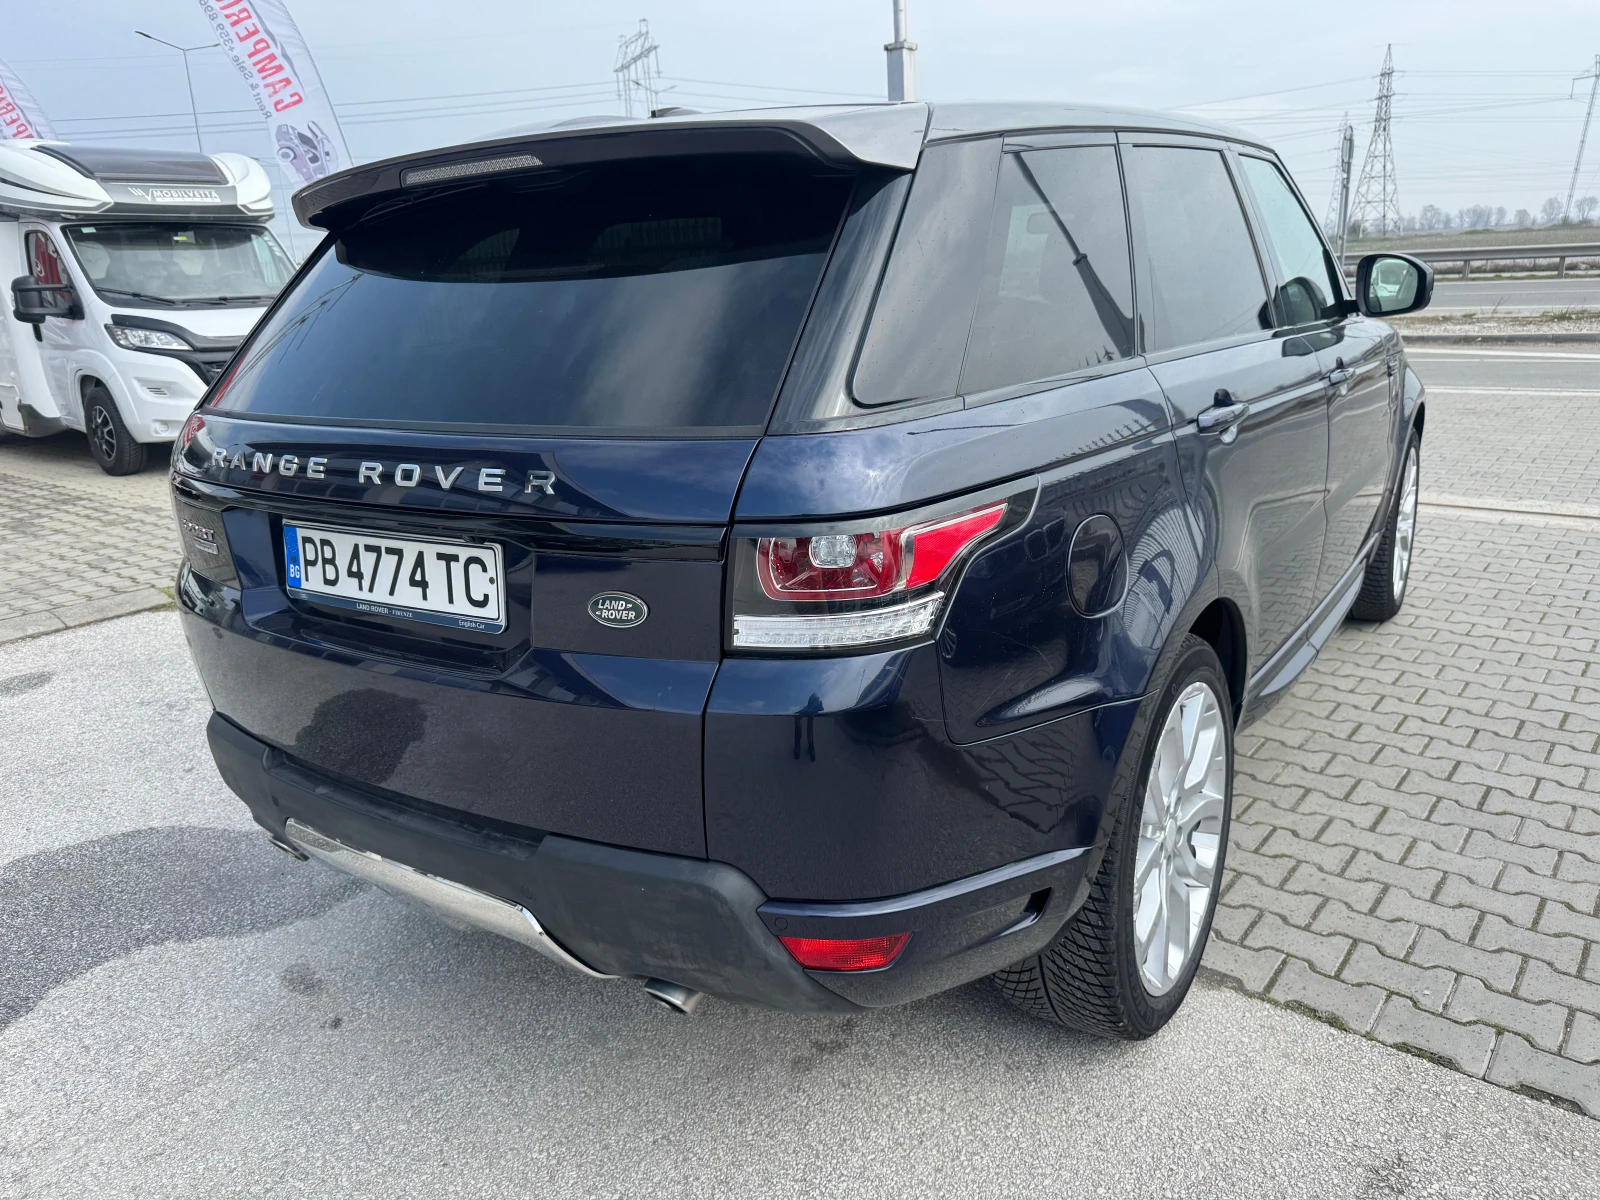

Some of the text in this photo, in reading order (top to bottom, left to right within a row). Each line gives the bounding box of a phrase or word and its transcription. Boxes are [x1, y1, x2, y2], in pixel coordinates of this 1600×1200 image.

[152, 190, 220, 199] MOBILVETTA
[211, 447, 556, 495] RANGE ROVER
[289, 563, 301, 579] BG
[301, 535, 490, 609] PB 4774 TC
[356, 602, 370, 611] LAND
[370, 605, 389, 615] ROVER
[392, 609, 414, 618] FIRENZE
[598, 599, 626, 610] LAND
[601, 609, 636, 620] ROVER
[458, 619, 486, 630] English Car
